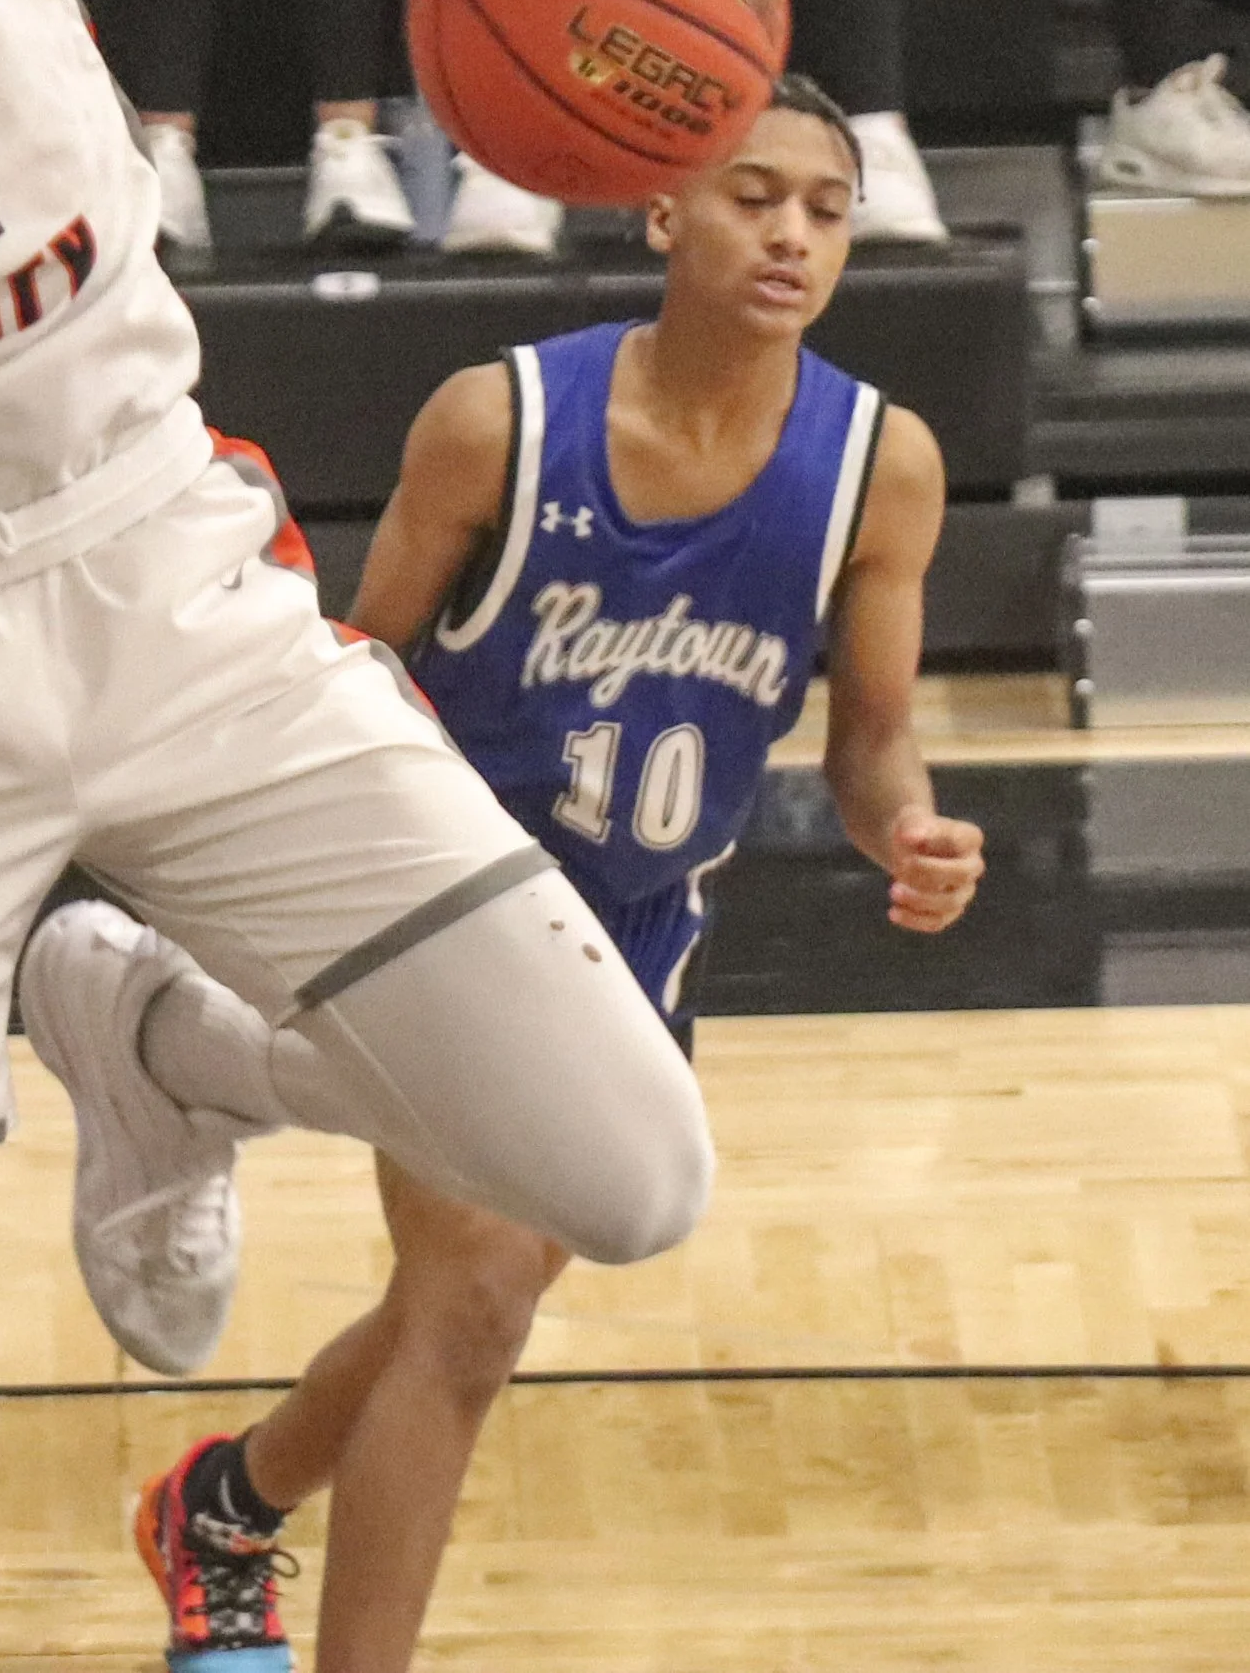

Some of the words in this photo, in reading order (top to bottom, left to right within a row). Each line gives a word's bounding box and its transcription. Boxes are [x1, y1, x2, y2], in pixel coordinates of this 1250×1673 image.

[569, 5, 744, 115] LEGACY
[520, 580, 789, 709] Raytown
[552, 721, 706, 851] 10
